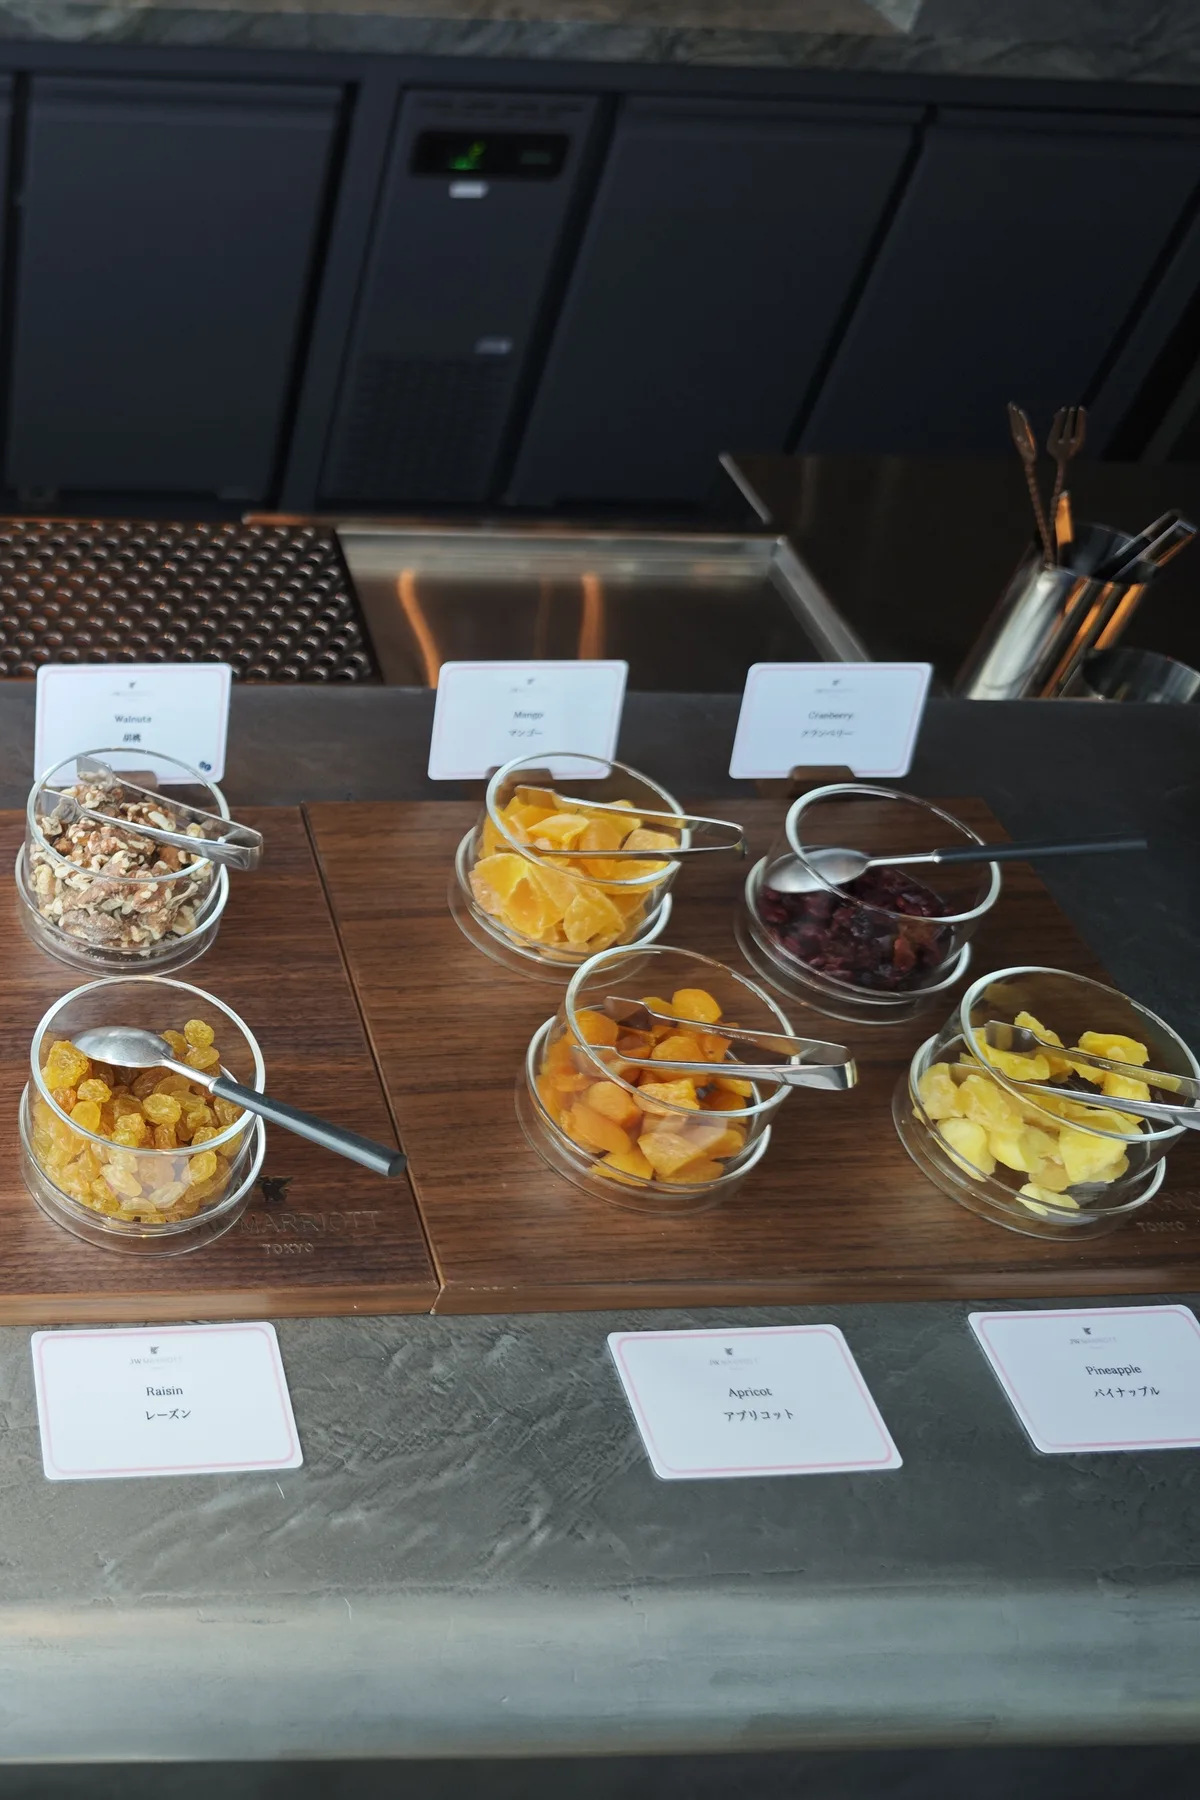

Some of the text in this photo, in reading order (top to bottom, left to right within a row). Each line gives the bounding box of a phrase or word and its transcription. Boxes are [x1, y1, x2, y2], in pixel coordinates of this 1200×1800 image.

[513, 711, 544, 720] Mango
[808, 711, 854, 721] Cranberry
[241, 1210, 379, 1233] MARRIOTT
[1085, 1364, 1142, 1377] Pineapple
[146, 1386, 184, 1397] Raisin
[728, 1387, 773, 1400] Apricot
[145, 1408, 192, 1421] レーズン
